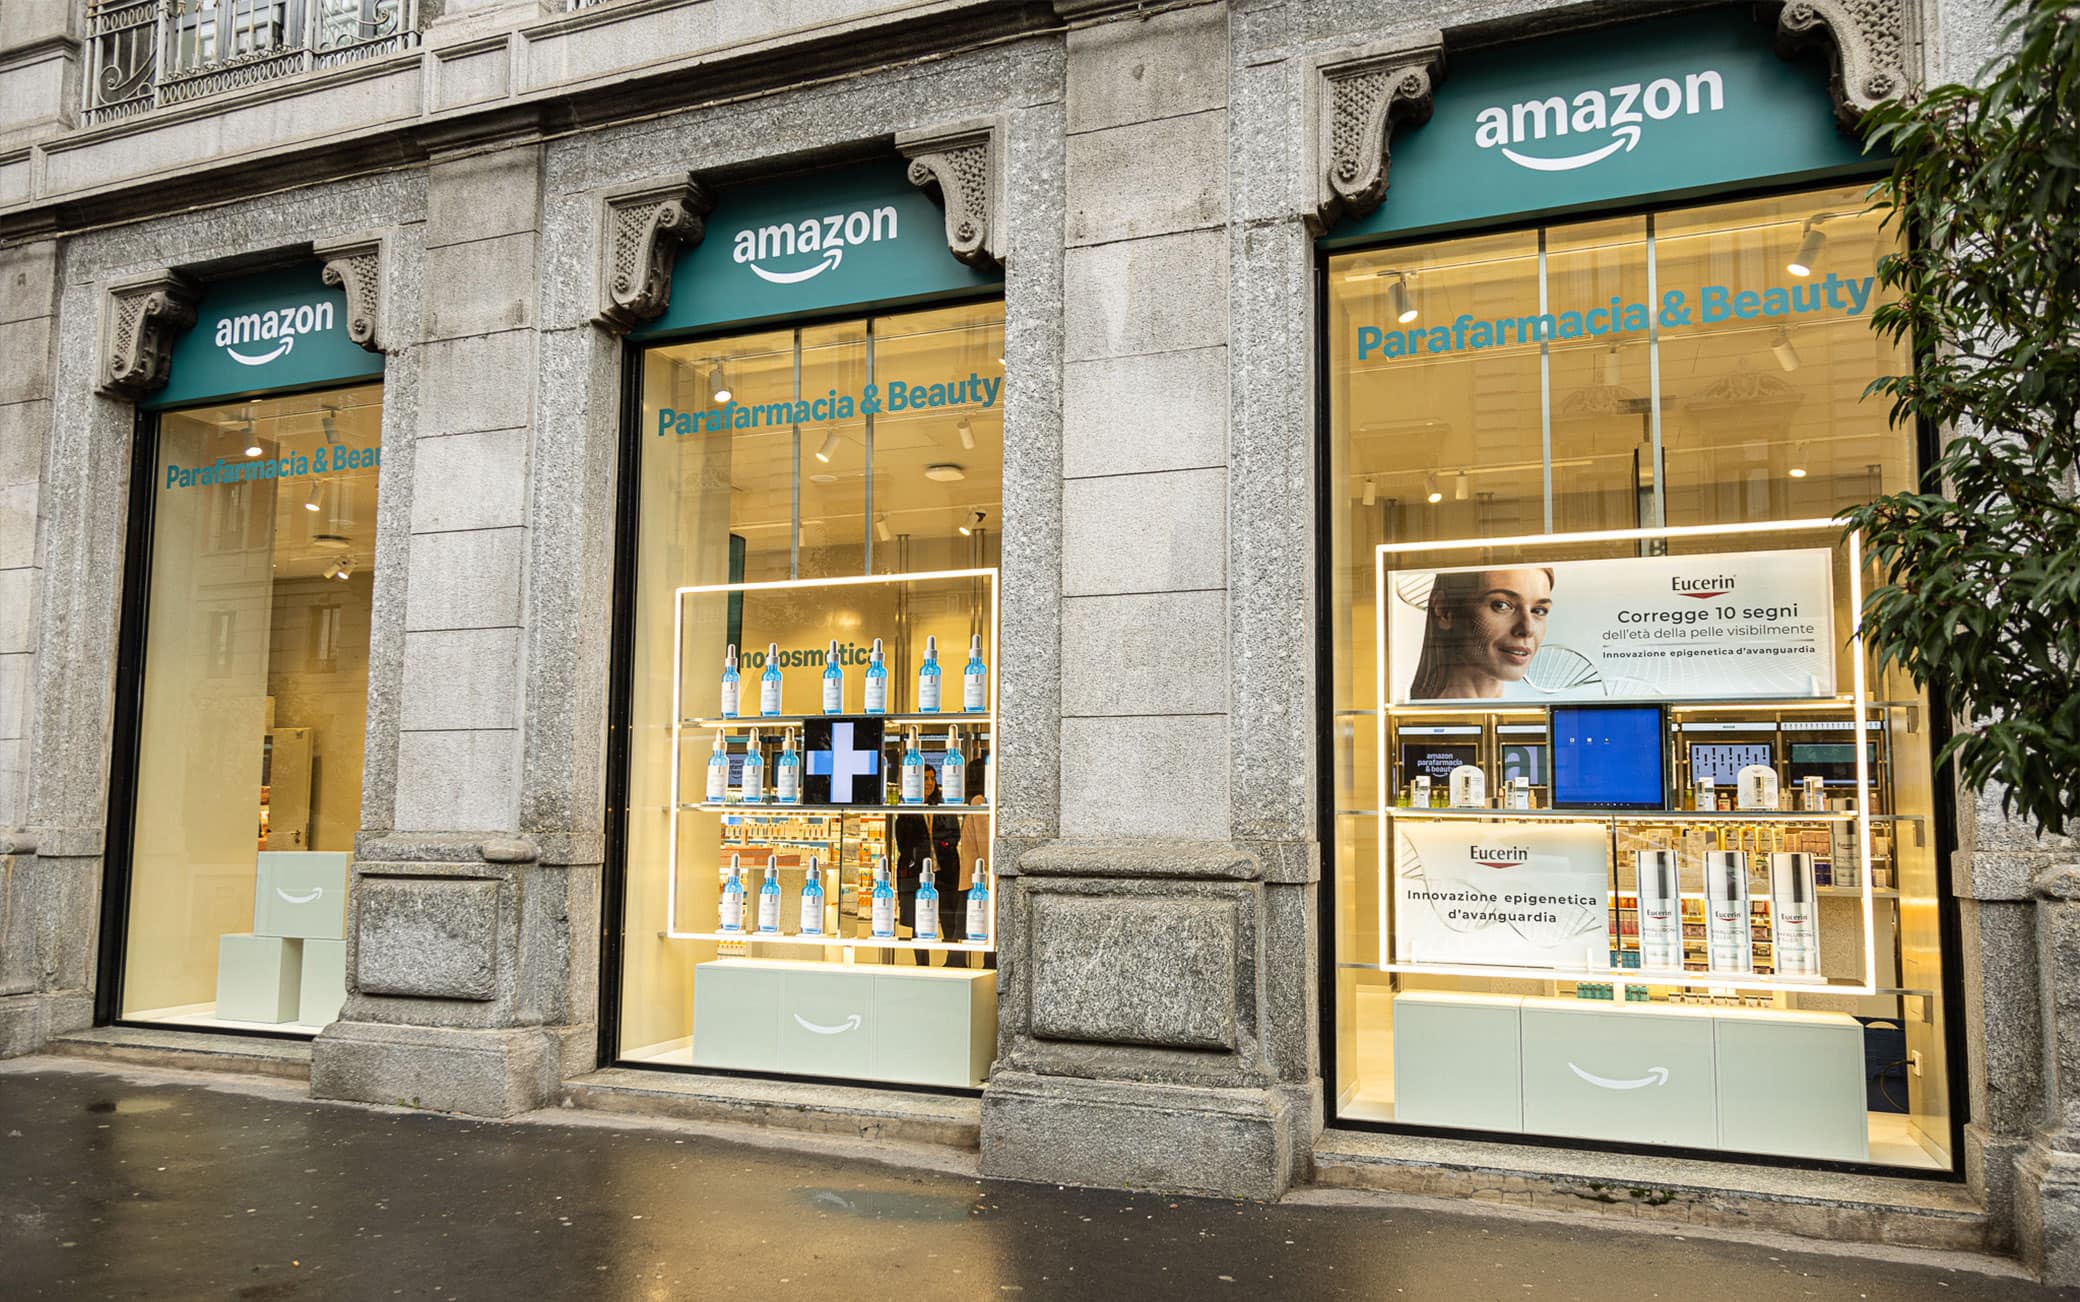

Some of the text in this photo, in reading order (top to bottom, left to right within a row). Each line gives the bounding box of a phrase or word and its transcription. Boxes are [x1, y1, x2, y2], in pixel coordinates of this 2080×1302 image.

[1474, 70, 1724, 148] amazon
[732, 205, 898, 264] amazon
[215, 301, 334, 347] amazon
[1357, 272, 1875, 360] Parafarmacia & Beauty
[658, 373, 1002, 437] Parafarmacia & Beauty
[166, 451, 308, 489] Parafarmacia
[312, 447, 328, 474] &
[1672, 575, 1735, 591] Eucerin
[1617, 603, 1798, 625] Corregge 10 segni
[1602, 624, 1815, 640] dell'età della pelle visibilmente
[1602, 646, 1815, 659] Innovazione epigenetica d'avanguardia
[1417, 758, 1463, 767] parafarmacia
[1470, 845, 1528, 860] Eucerin
[1407, 890, 1597, 906] Innovazione epigenetica
[1448, 909, 1557, 923] d'avanguardia
